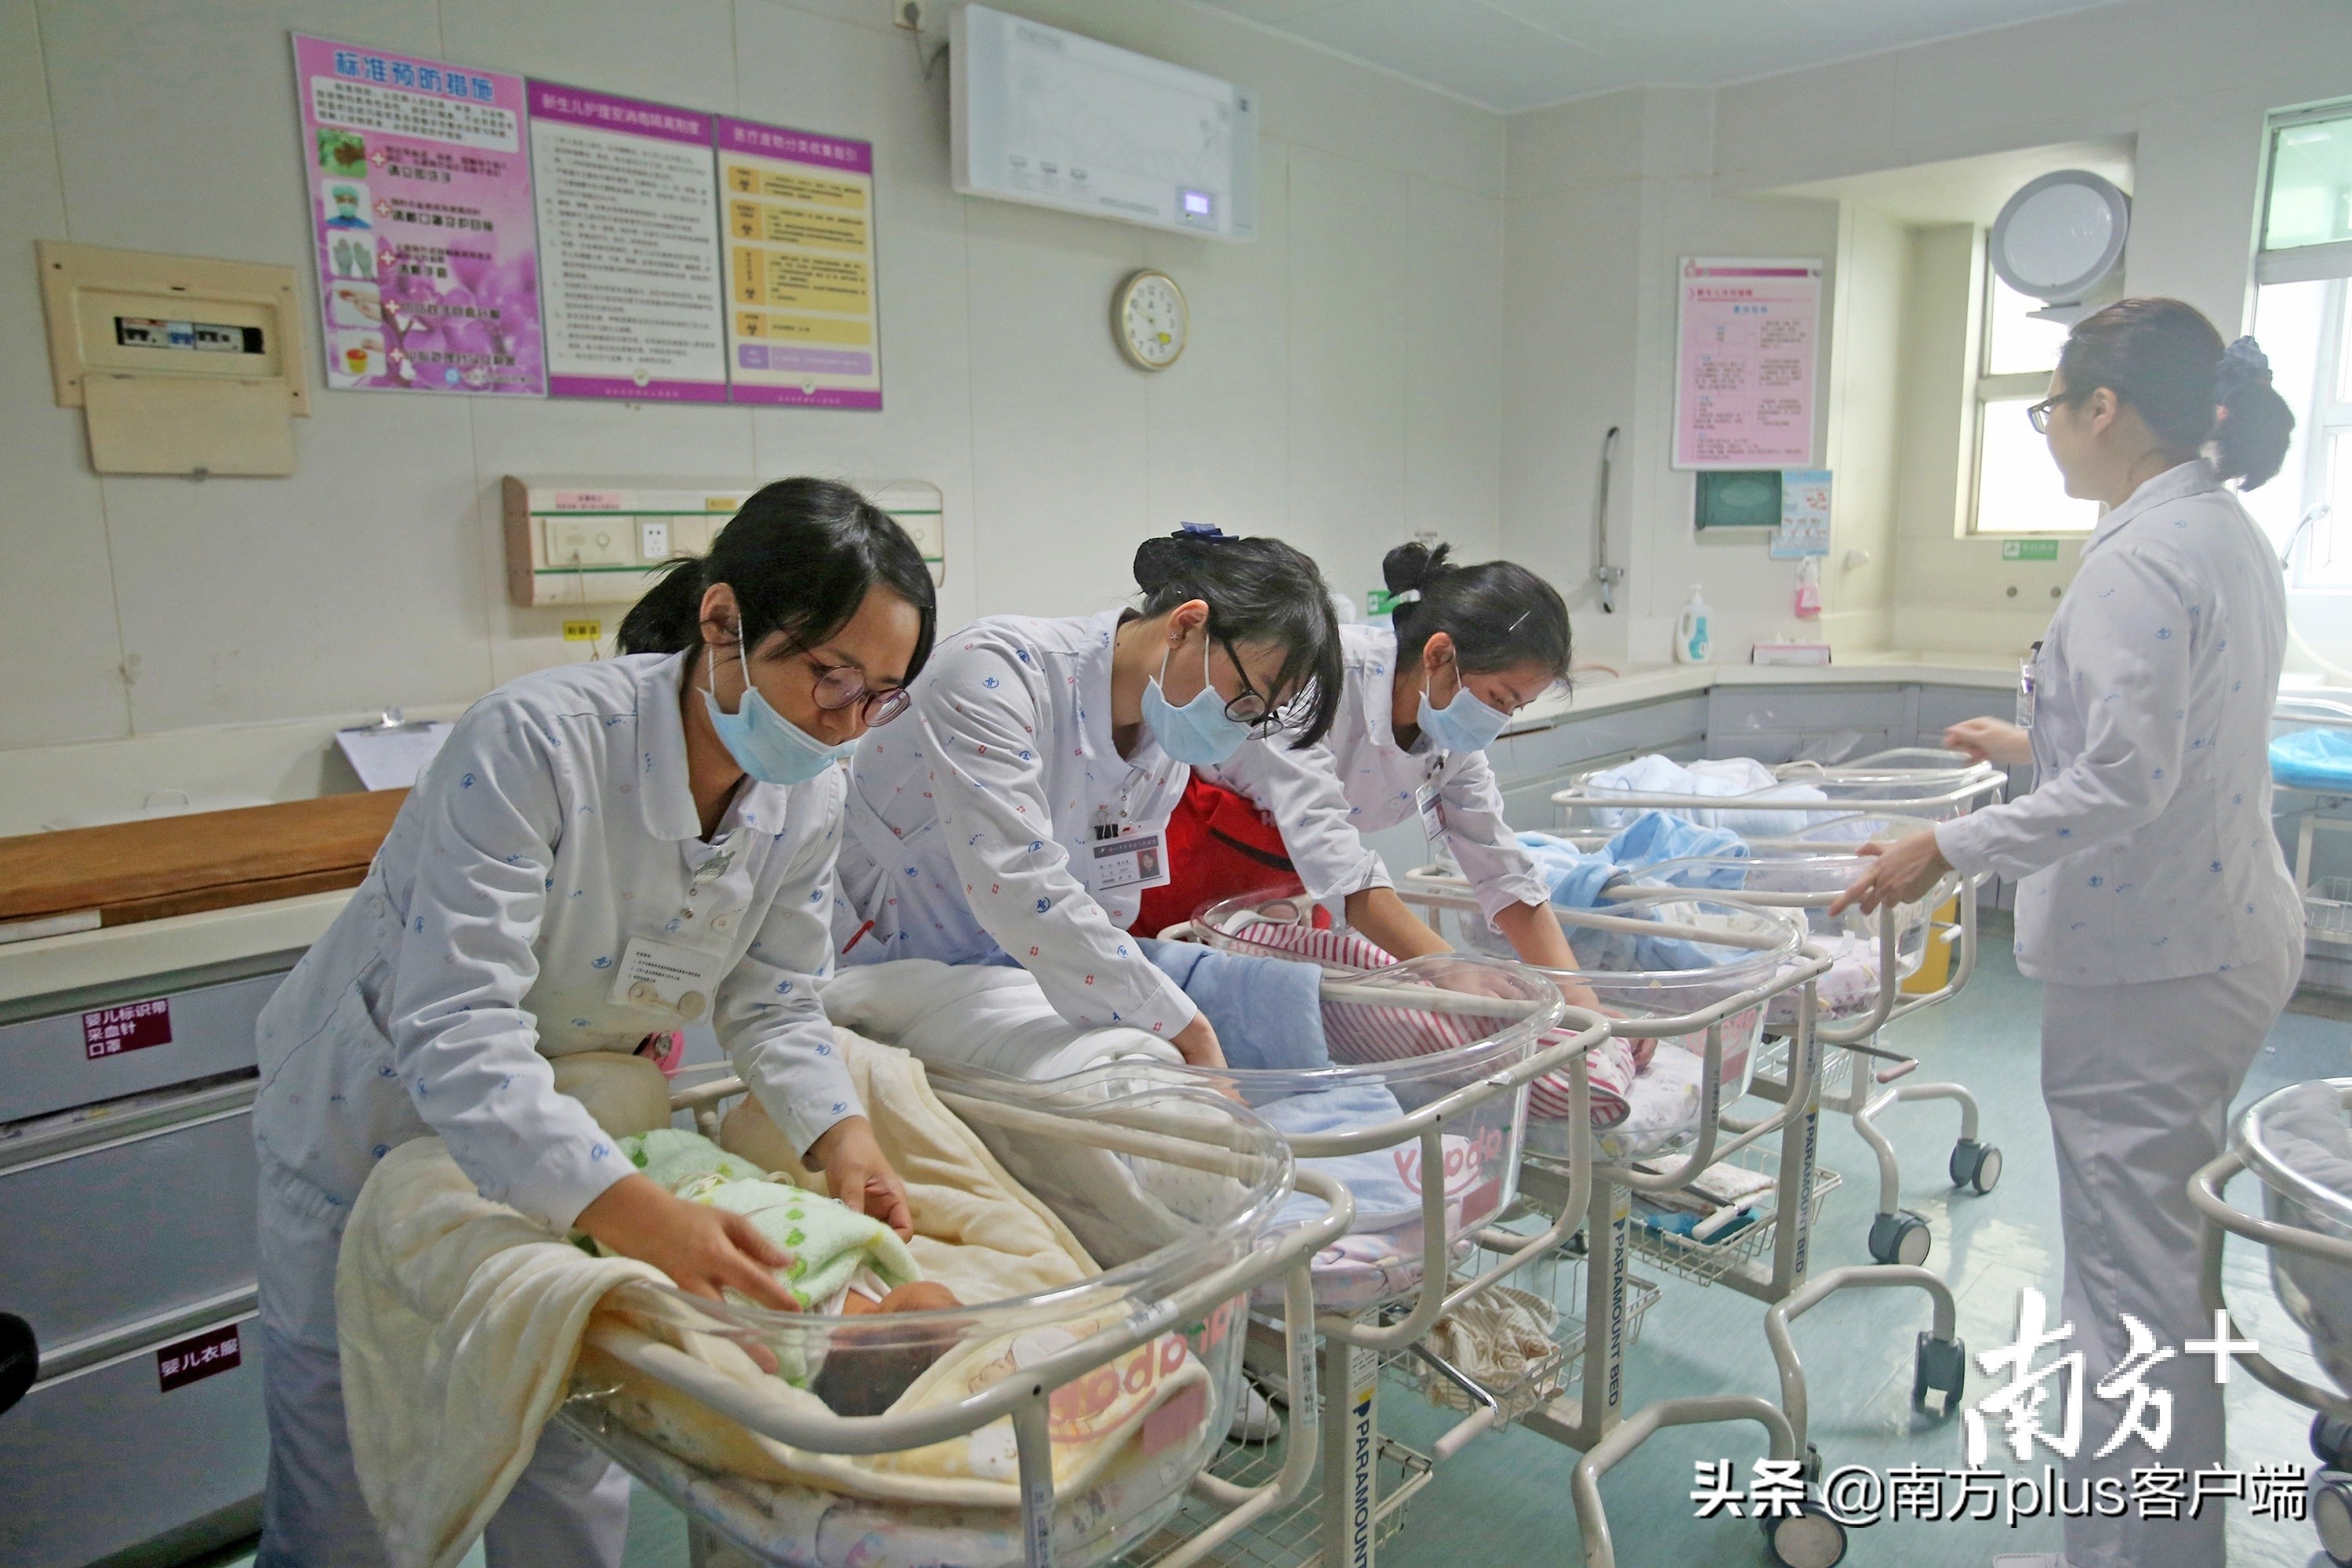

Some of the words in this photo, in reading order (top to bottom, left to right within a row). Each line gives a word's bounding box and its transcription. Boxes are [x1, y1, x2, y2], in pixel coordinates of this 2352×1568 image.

[335, 50, 495, 102] 标准预防措施
[85, 1000, 167, 1029] 婴儿标识带
[87, 1019, 137, 1042] 采血针
[89, 1037, 122, 1057] 口罩
[1798, 1124, 1816, 1233] PARAMOUNT
[1795, 1236, 1810, 1273] BED
[1610, 1234, 1627, 1362] PARAMOUNT
[161, 1338, 239, 1377] 婴儿衣服
[1608, 1366, 1621, 1407] BED
